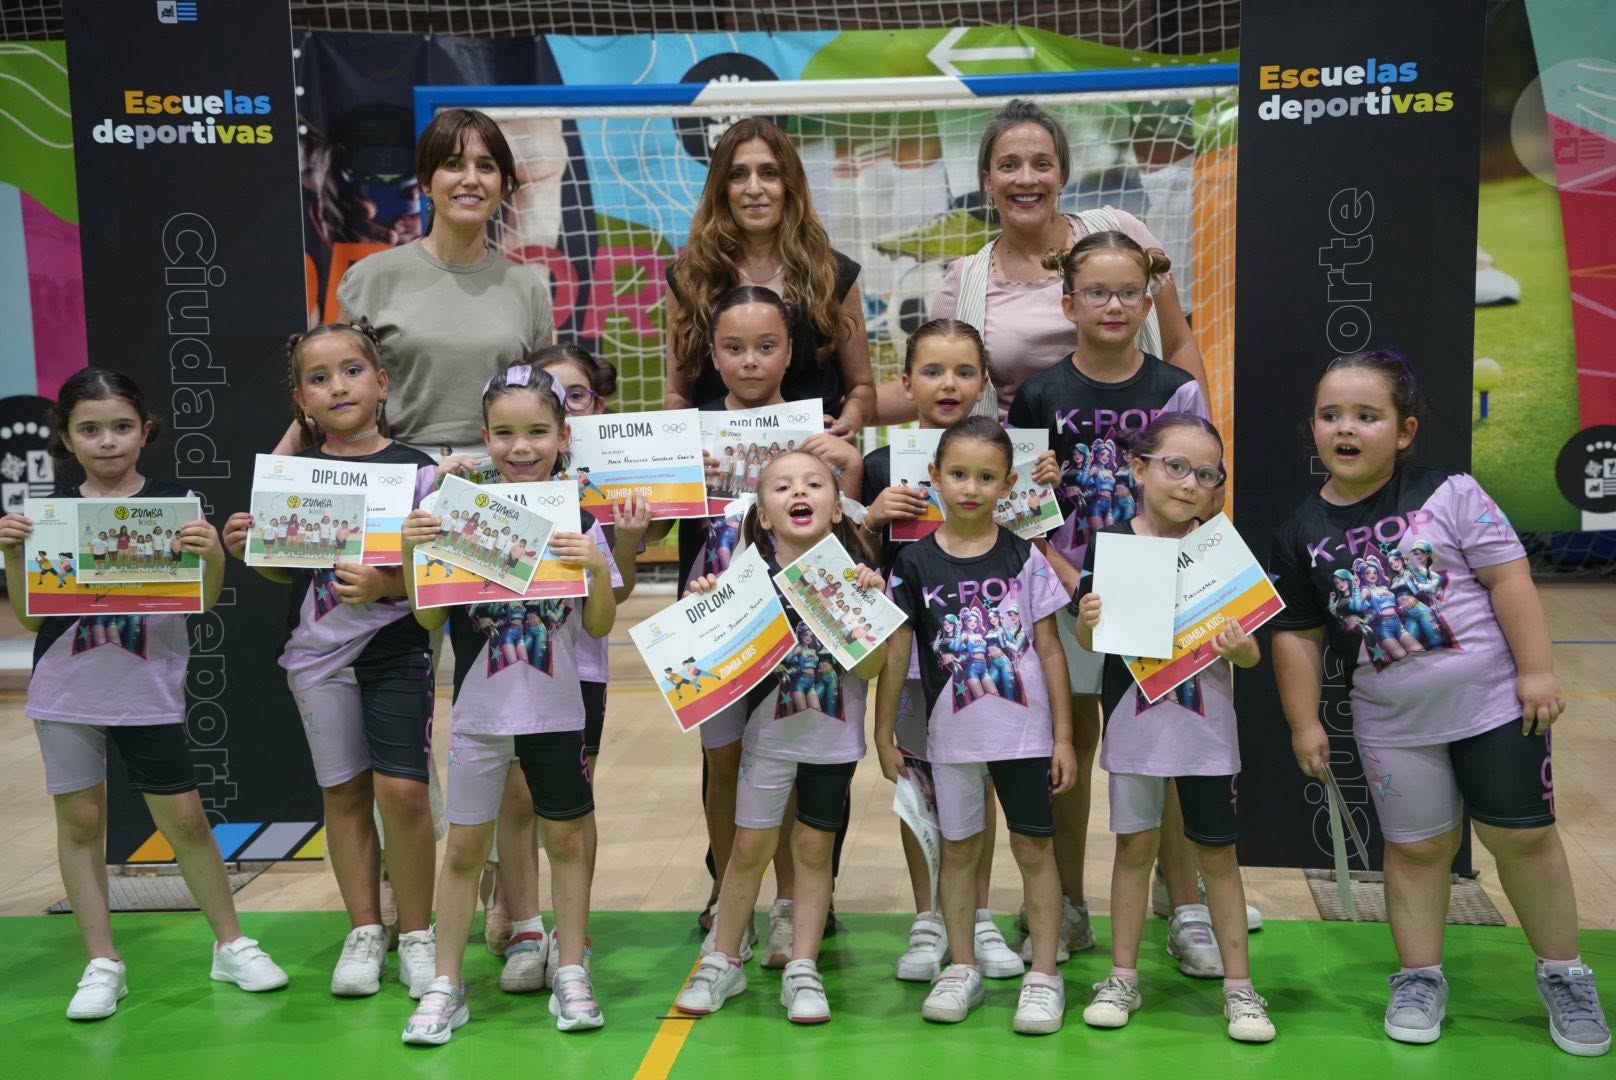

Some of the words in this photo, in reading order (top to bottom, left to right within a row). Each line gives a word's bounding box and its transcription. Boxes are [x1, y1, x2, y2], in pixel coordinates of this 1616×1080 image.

[1259, 58, 1418, 90] Escuelas
[124, 89, 272, 114] Escuelas
[1258, 86, 1454, 125] deportivas
[92, 116, 273, 149] deportivas
[162, 212, 231, 479] Ciudad
[599, 422, 654, 440] DIPLOMA
[311, 468, 369, 487] DIPLOMA
[483, 468, 502, 480] ZUM
[130, 508, 163, 519] ZUMBA
[302, 497, 332, 509] ZUMBA
[489, 500, 520, 521] ZUMBA
[1306, 508, 1434, 568] K-POP
[685, 583, 736, 625] DIPLOMA
[922, 577, 1023, 608] K-POP
[1178, 626, 1208, 648] ZUMBA
[1206, 613, 1225, 632] KIDS
[718, 657, 744, 679] ZUMBA
[741, 645, 757, 664] KIDS
[185, 588, 237, 823] eport
